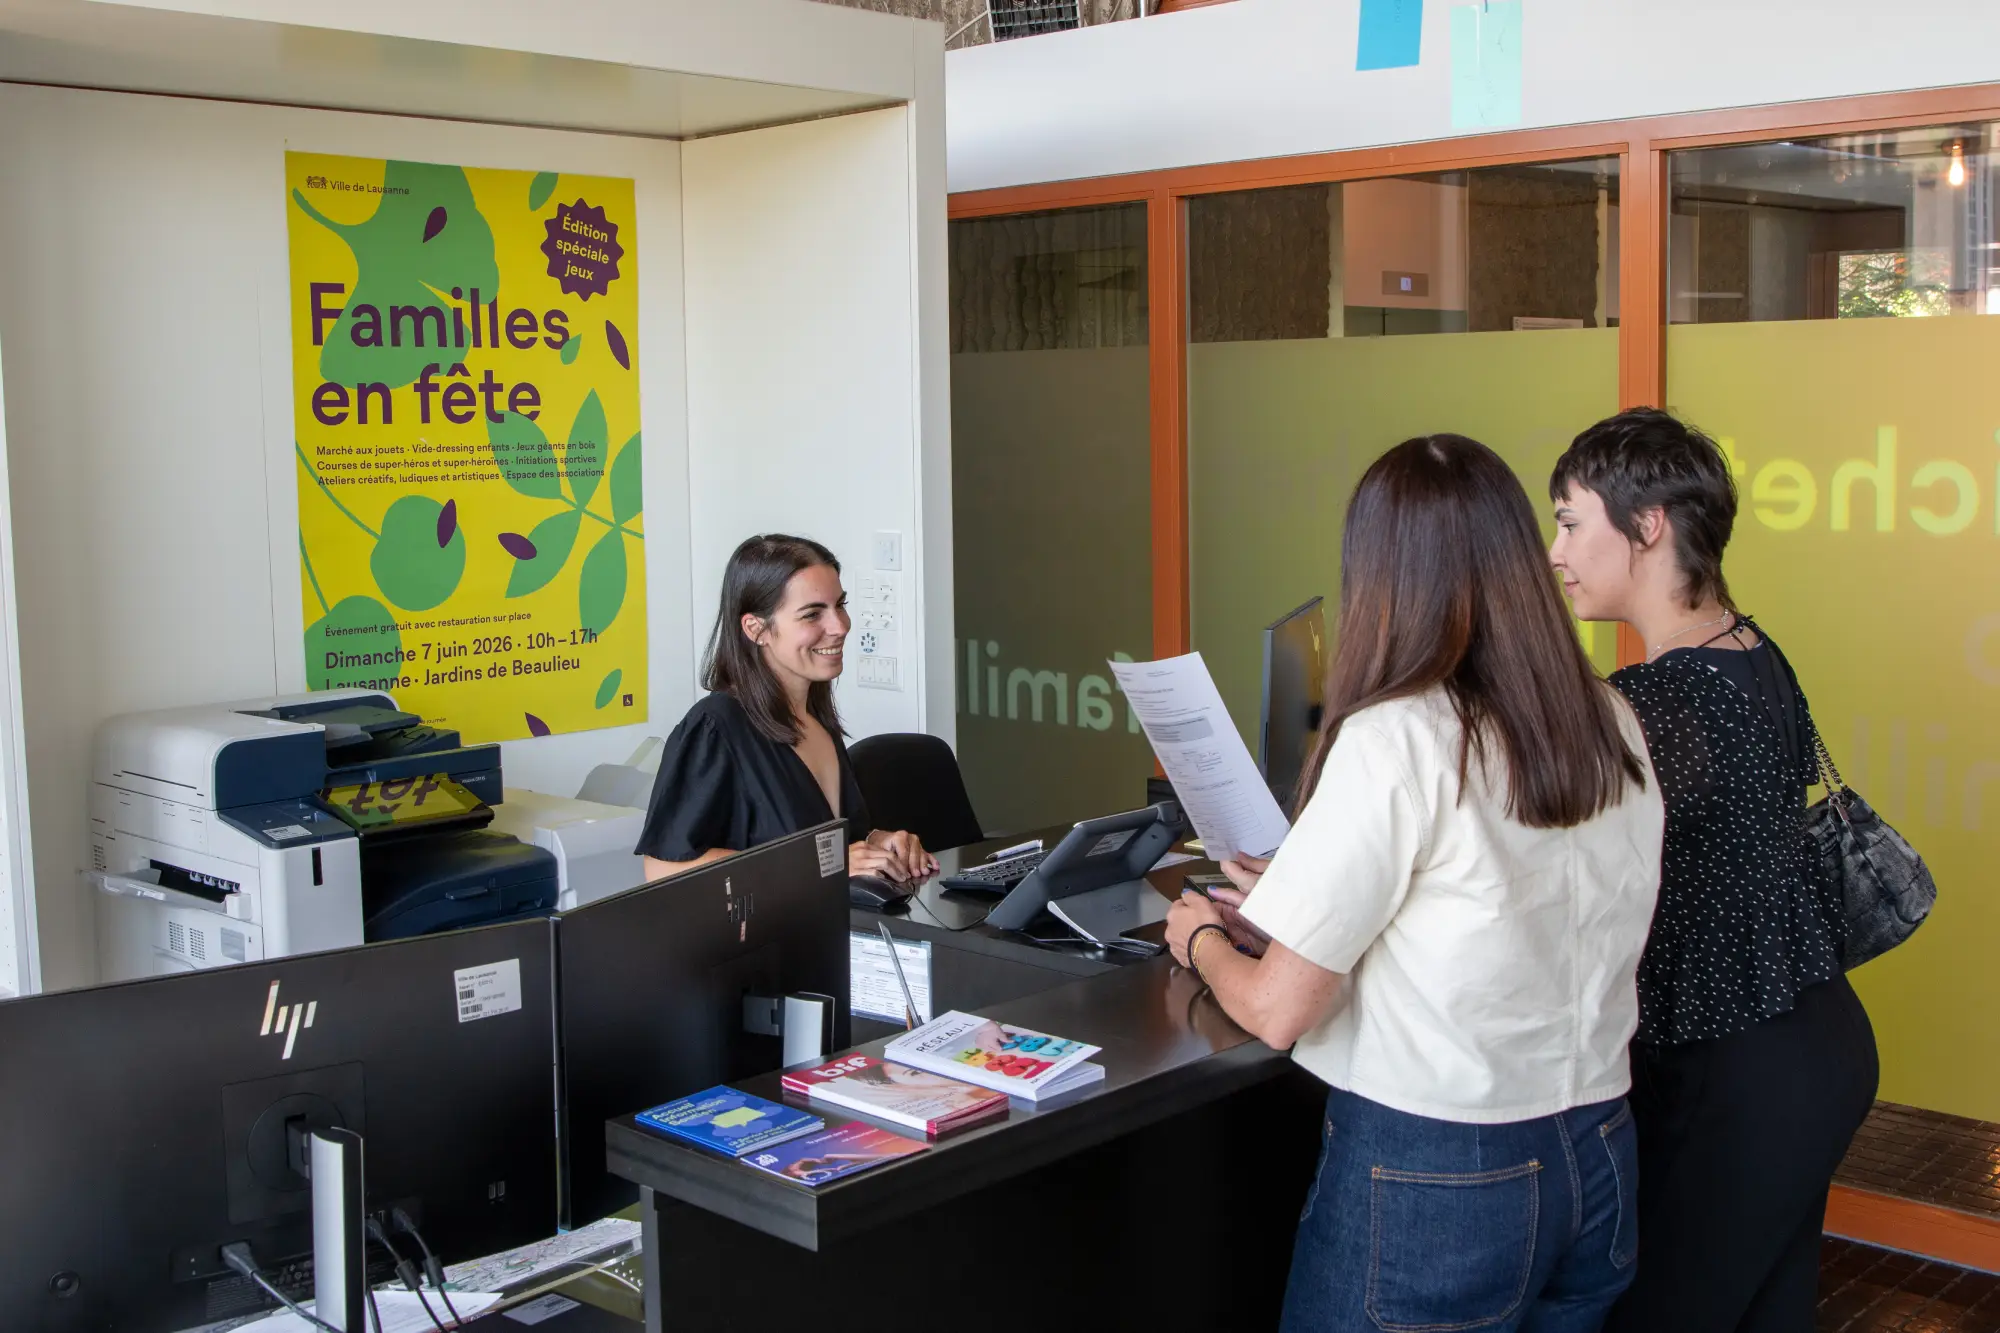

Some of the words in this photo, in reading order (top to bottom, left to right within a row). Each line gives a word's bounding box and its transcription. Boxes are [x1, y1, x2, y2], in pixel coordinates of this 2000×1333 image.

[329, 180, 350, 191] Ville
[352, 182, 365, 192] de
[367, 183, 410, 195] Lausanne
[562, 213, 609, 243] Édition
[556, 239, 610, 264] spéciale
[564, 260, 594, 281] jeux
[309, 281, 571, 350] Familles
[311, 381, 393, 426] en
[413, 363, 542, 425] fête
[316, 445, 353, 456] Marché
[355, 447, 373, 455] aux
[374, 445, 405, 457] jouets
[412, 443, 475, 455] Vide-dressing
[476, 442, 510, 452] enfants
[516, 442, 535, 451] Jeux
[537, 441, 566, 453] géants
[566, 442, 577, 450] en
[578, 440, 596, 450] bois
[317, 460, 358, 471] Courses
[360, 460, 372, 470] de
[374, 459, 430, 471] super-héros
[432, 459, 441, 468] et
[443, 456, 509, 470] super-héroïnes
[515, 456, 558, 466] Initiations
[559, 454, 597, 466] sportives
[318, 475, 356, 486] Ateliers
[358, 474, 397, 485] créatifs,
[399, 473, 438, 485] ludiques
[440, 473, 450, 482] et
[452, 471, 500, 482] artistiques
[506, 470, 537, 482] Espace
[538, 469, 555, 479] des
[556, 469, 605, 479] associations
[380, 621, 412, 634] gratuit
[414, 620, 436, 629] avec
[437, 614, 491, 628] restauration
[493, 614, 507, 623] sur
[508, 611, 532, 624] place
[325, 645, 416, 670] Dimanche
[421, 643, 432, 660] 7
[436, 641, 468, 664] juin
[472, 635, 513, 655] 2026
[423, 665, 483, 687] Jardins
[487, 661, 507, 678] de
[512, 655, 580, 676] Beaulieu
[260, 979, 318, 1060] hp
[811, 1056, 868, 1078] bif
